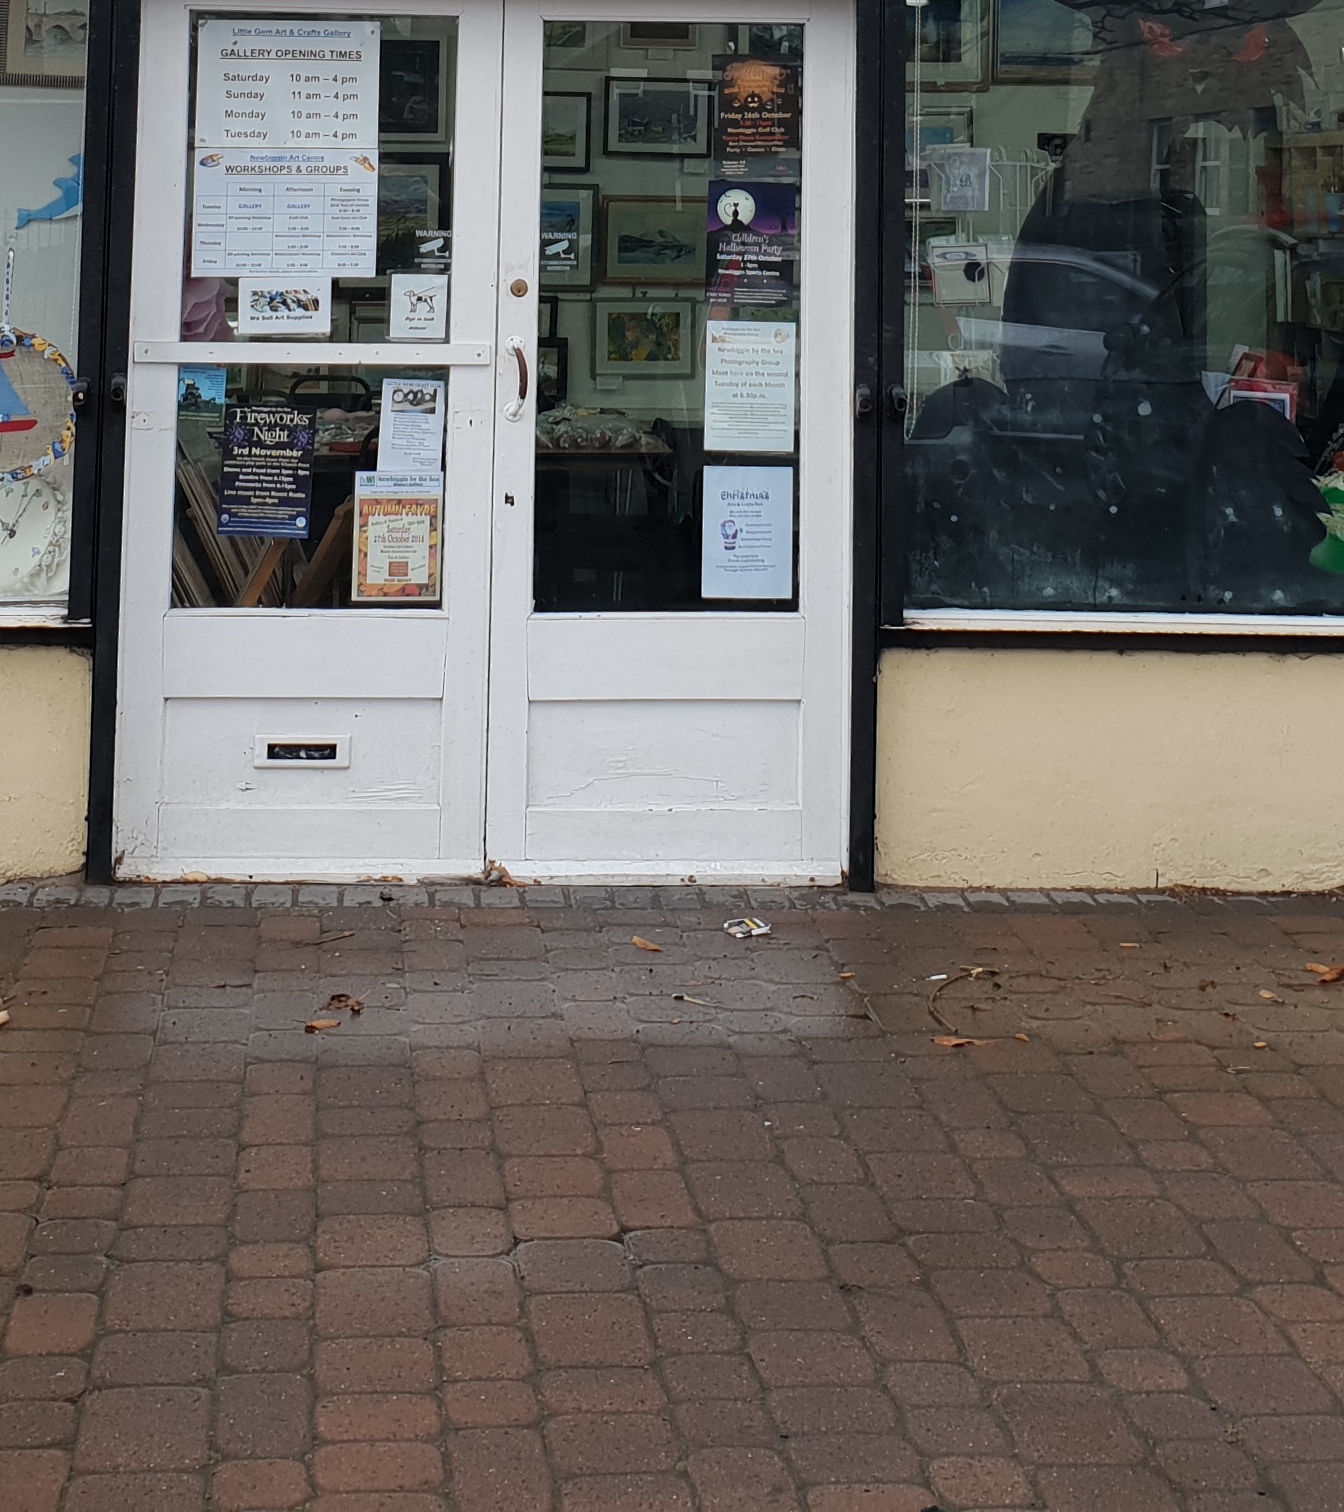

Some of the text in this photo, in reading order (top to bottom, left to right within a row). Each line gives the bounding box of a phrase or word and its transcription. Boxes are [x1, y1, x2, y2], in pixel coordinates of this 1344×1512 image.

[275, 28, 287, 36] Art
[323, 29, 352, 38] Gallery
[220, 49, 362, 60] GALLERY OPENING TIMES
[223, 73, 358, 85] Saturday 10 am 4 pm
[225, 90, 265, 101] Sunday
[291, 91, 301, 99] 11
[333, 92, 339, 100] 4
[342, 93, 359, 102] pm
[224, 110, 266, 121] Monday
[290, 111, 302, 119] 10
[333, 111, 339, 120] 4
[342, 113, 358, 122] pm
[720, 112, 742, 120] Friday
[224, 129, 268, 141] Tuesday
[290, 130, 301, 139] 10
[332, 131, 338, 139] 4
[341, 132, 358, 141] pm
[250, 155, 287, 163] Newbiggin
[225, 165, 349, 174] WORKSHOPS & GROUPS
[761, 245, 783, 255] Party
[721, 358, 759, 366] Photography
[229, 408, 314, 427] Fireworks
[252, 426, 290, 444] Night
[233, 447, 303, 457] 3rd November
[721, 489, 770, 500] Christmas
[363, 504, 402, 515] AUTUMN
